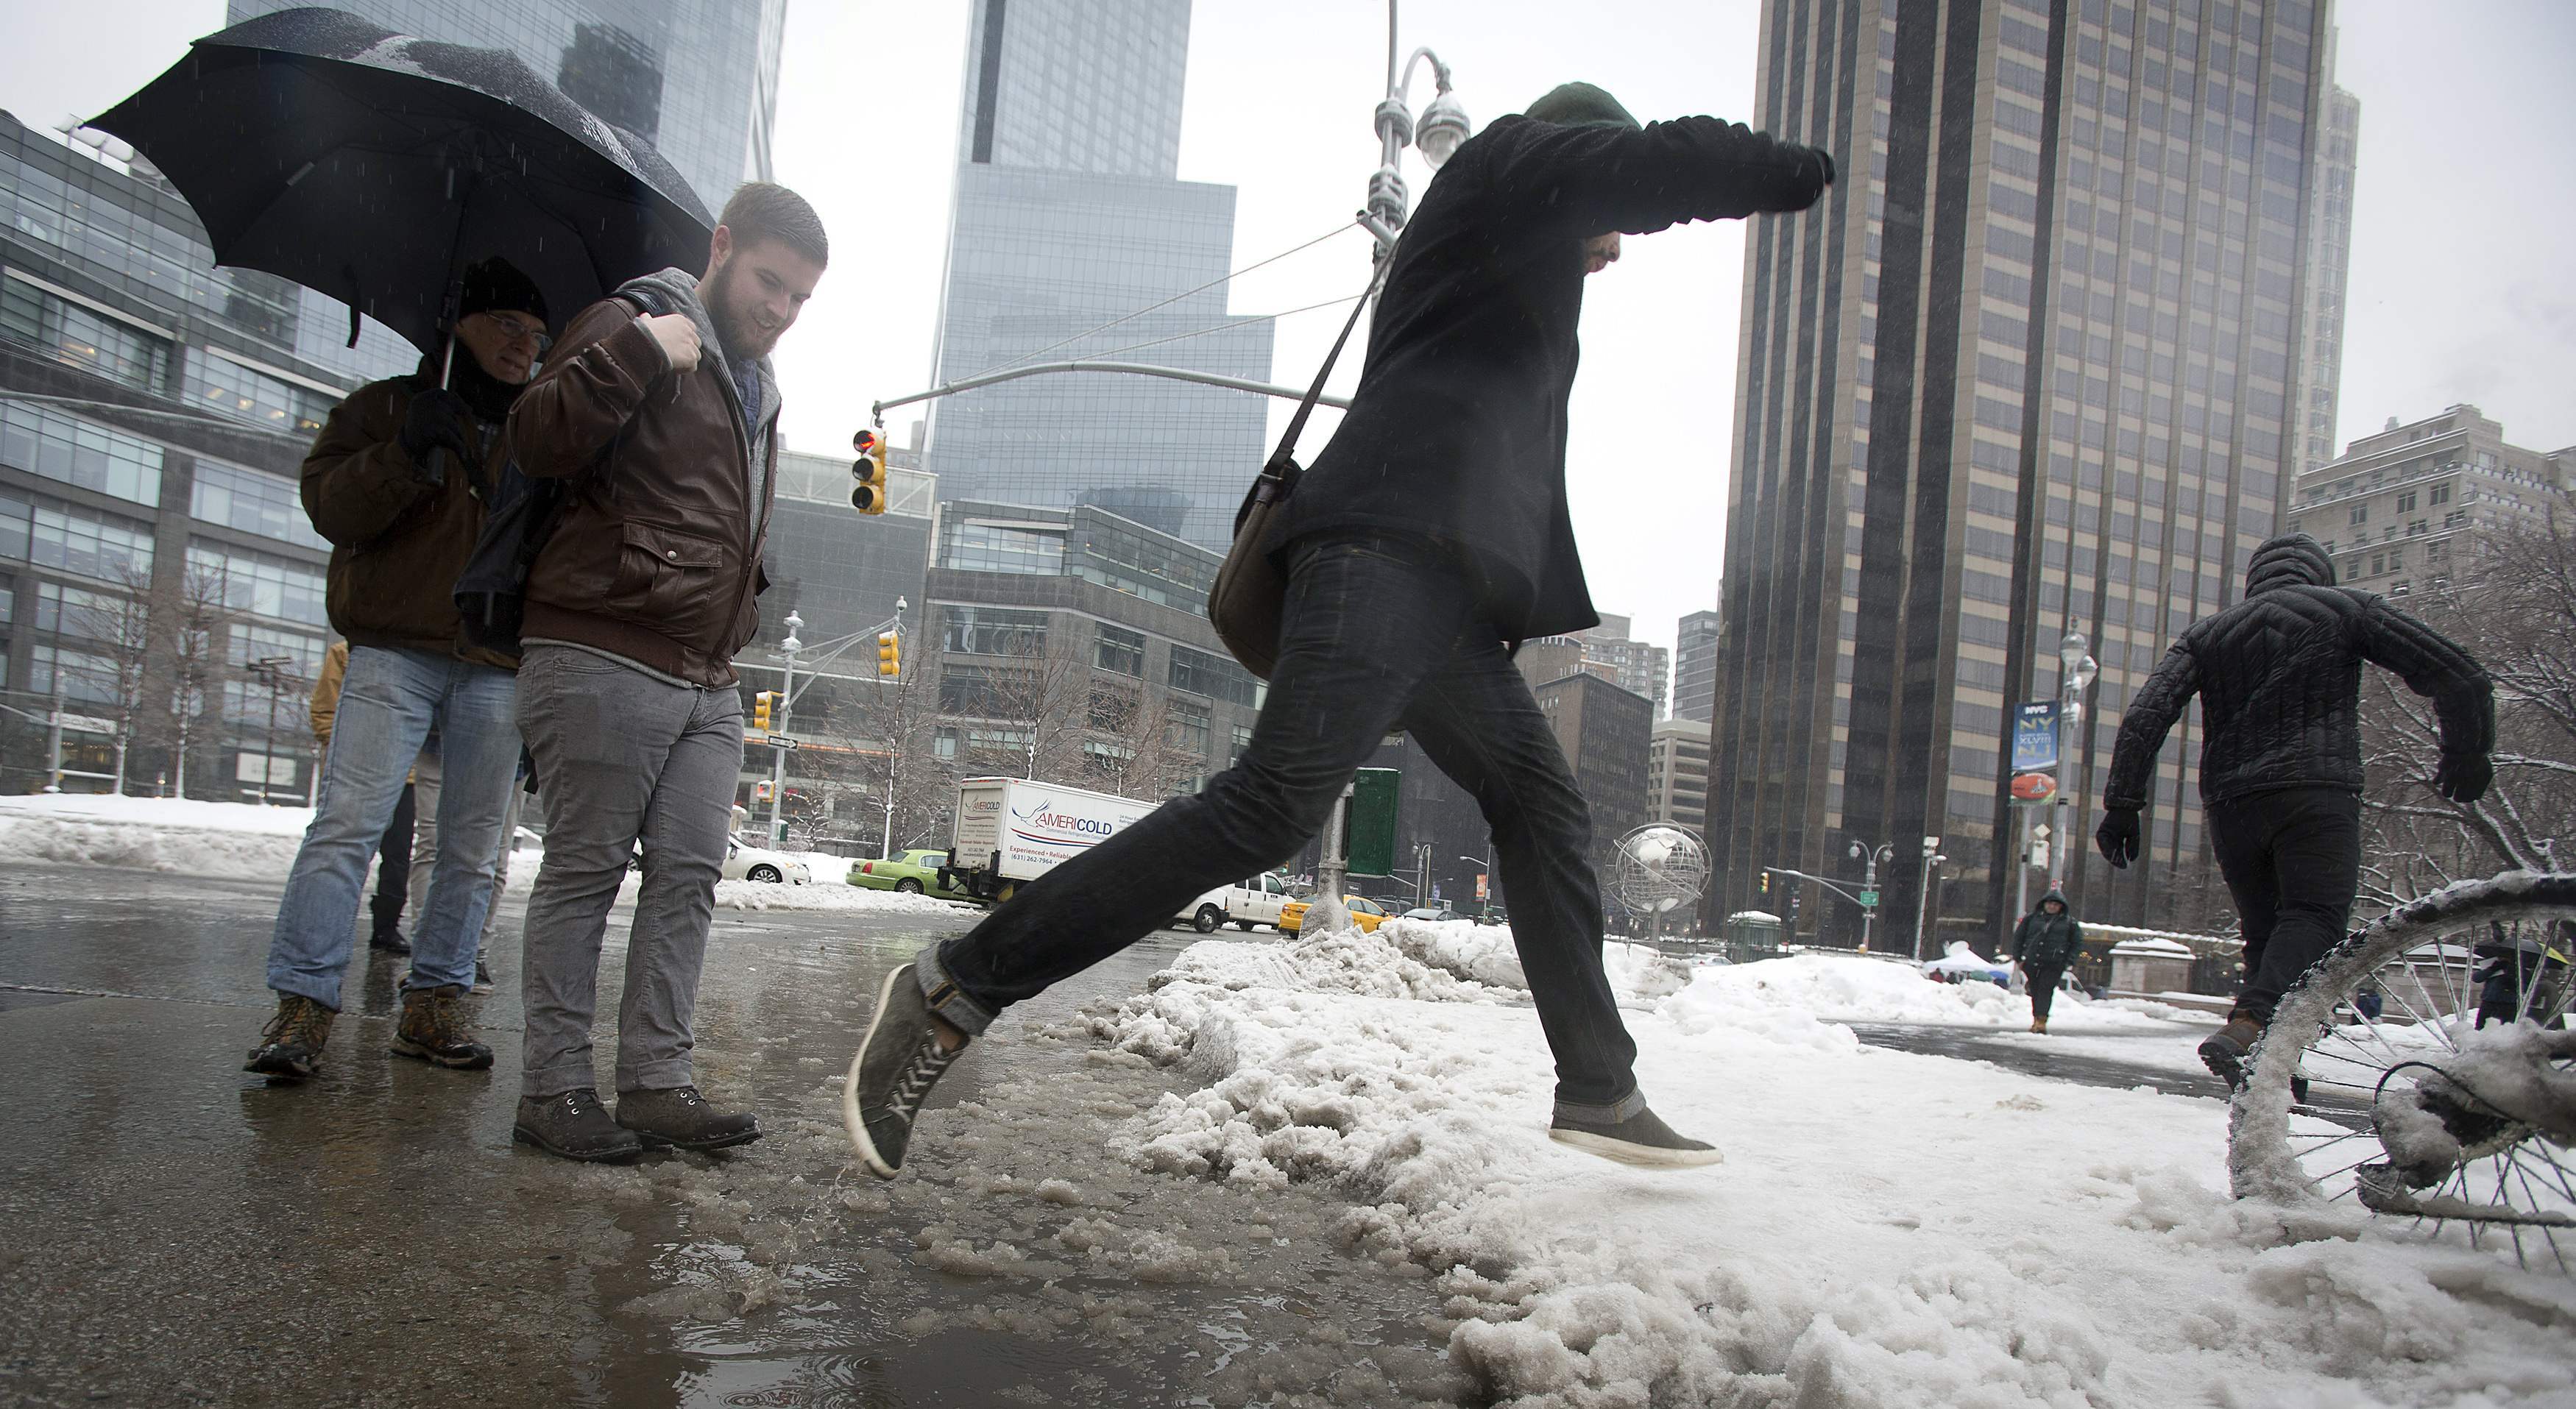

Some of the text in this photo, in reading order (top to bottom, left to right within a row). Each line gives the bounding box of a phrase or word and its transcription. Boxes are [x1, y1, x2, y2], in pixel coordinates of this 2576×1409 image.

[2025, 705, 2048, 714] NYC
[2020, 717, 2054, 731] NY
[2017, 743, 2050, 759] NJ
[973, 801, 1000, 810] AMERICOLD
[1035, 812, 1112, 835] AMERICOLD
[1009, 845, 1072, 860] Experienced Reliable
[1011, 853, 1052, 865] (631) 262-7964
